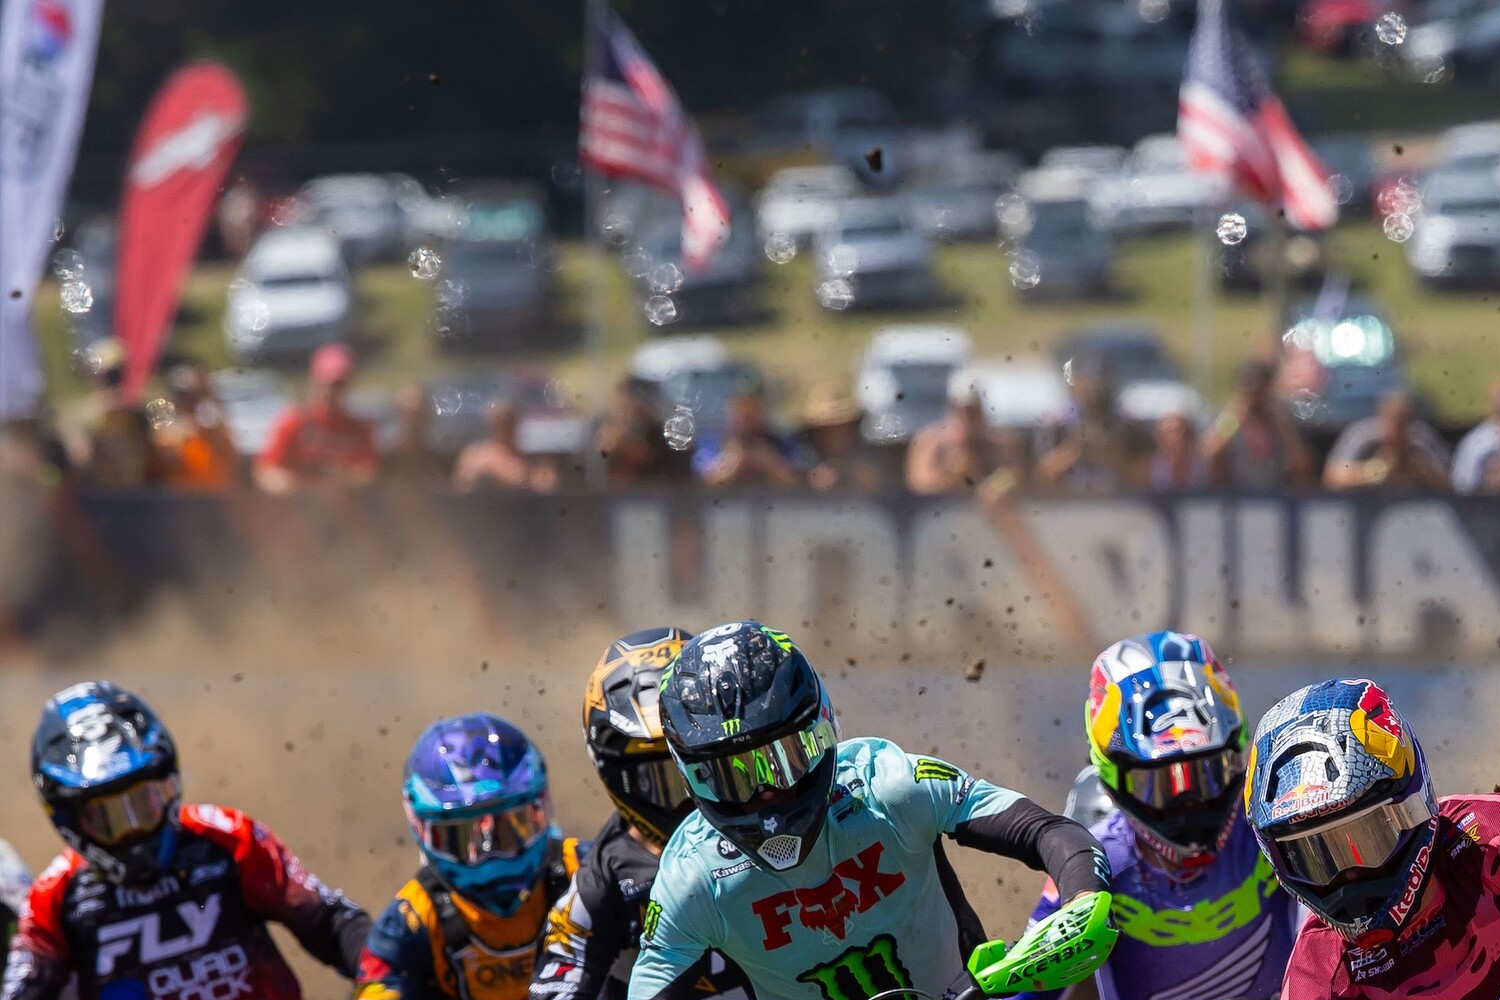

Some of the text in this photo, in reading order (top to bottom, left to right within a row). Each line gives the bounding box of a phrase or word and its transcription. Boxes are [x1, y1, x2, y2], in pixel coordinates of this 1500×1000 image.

[1271, 791, 1329, 820] Red Bull
[1388, 865, 1424, 927] Red
[97, 892, 222, 976] FLY
[149, 944, 248, 996] QUAD
